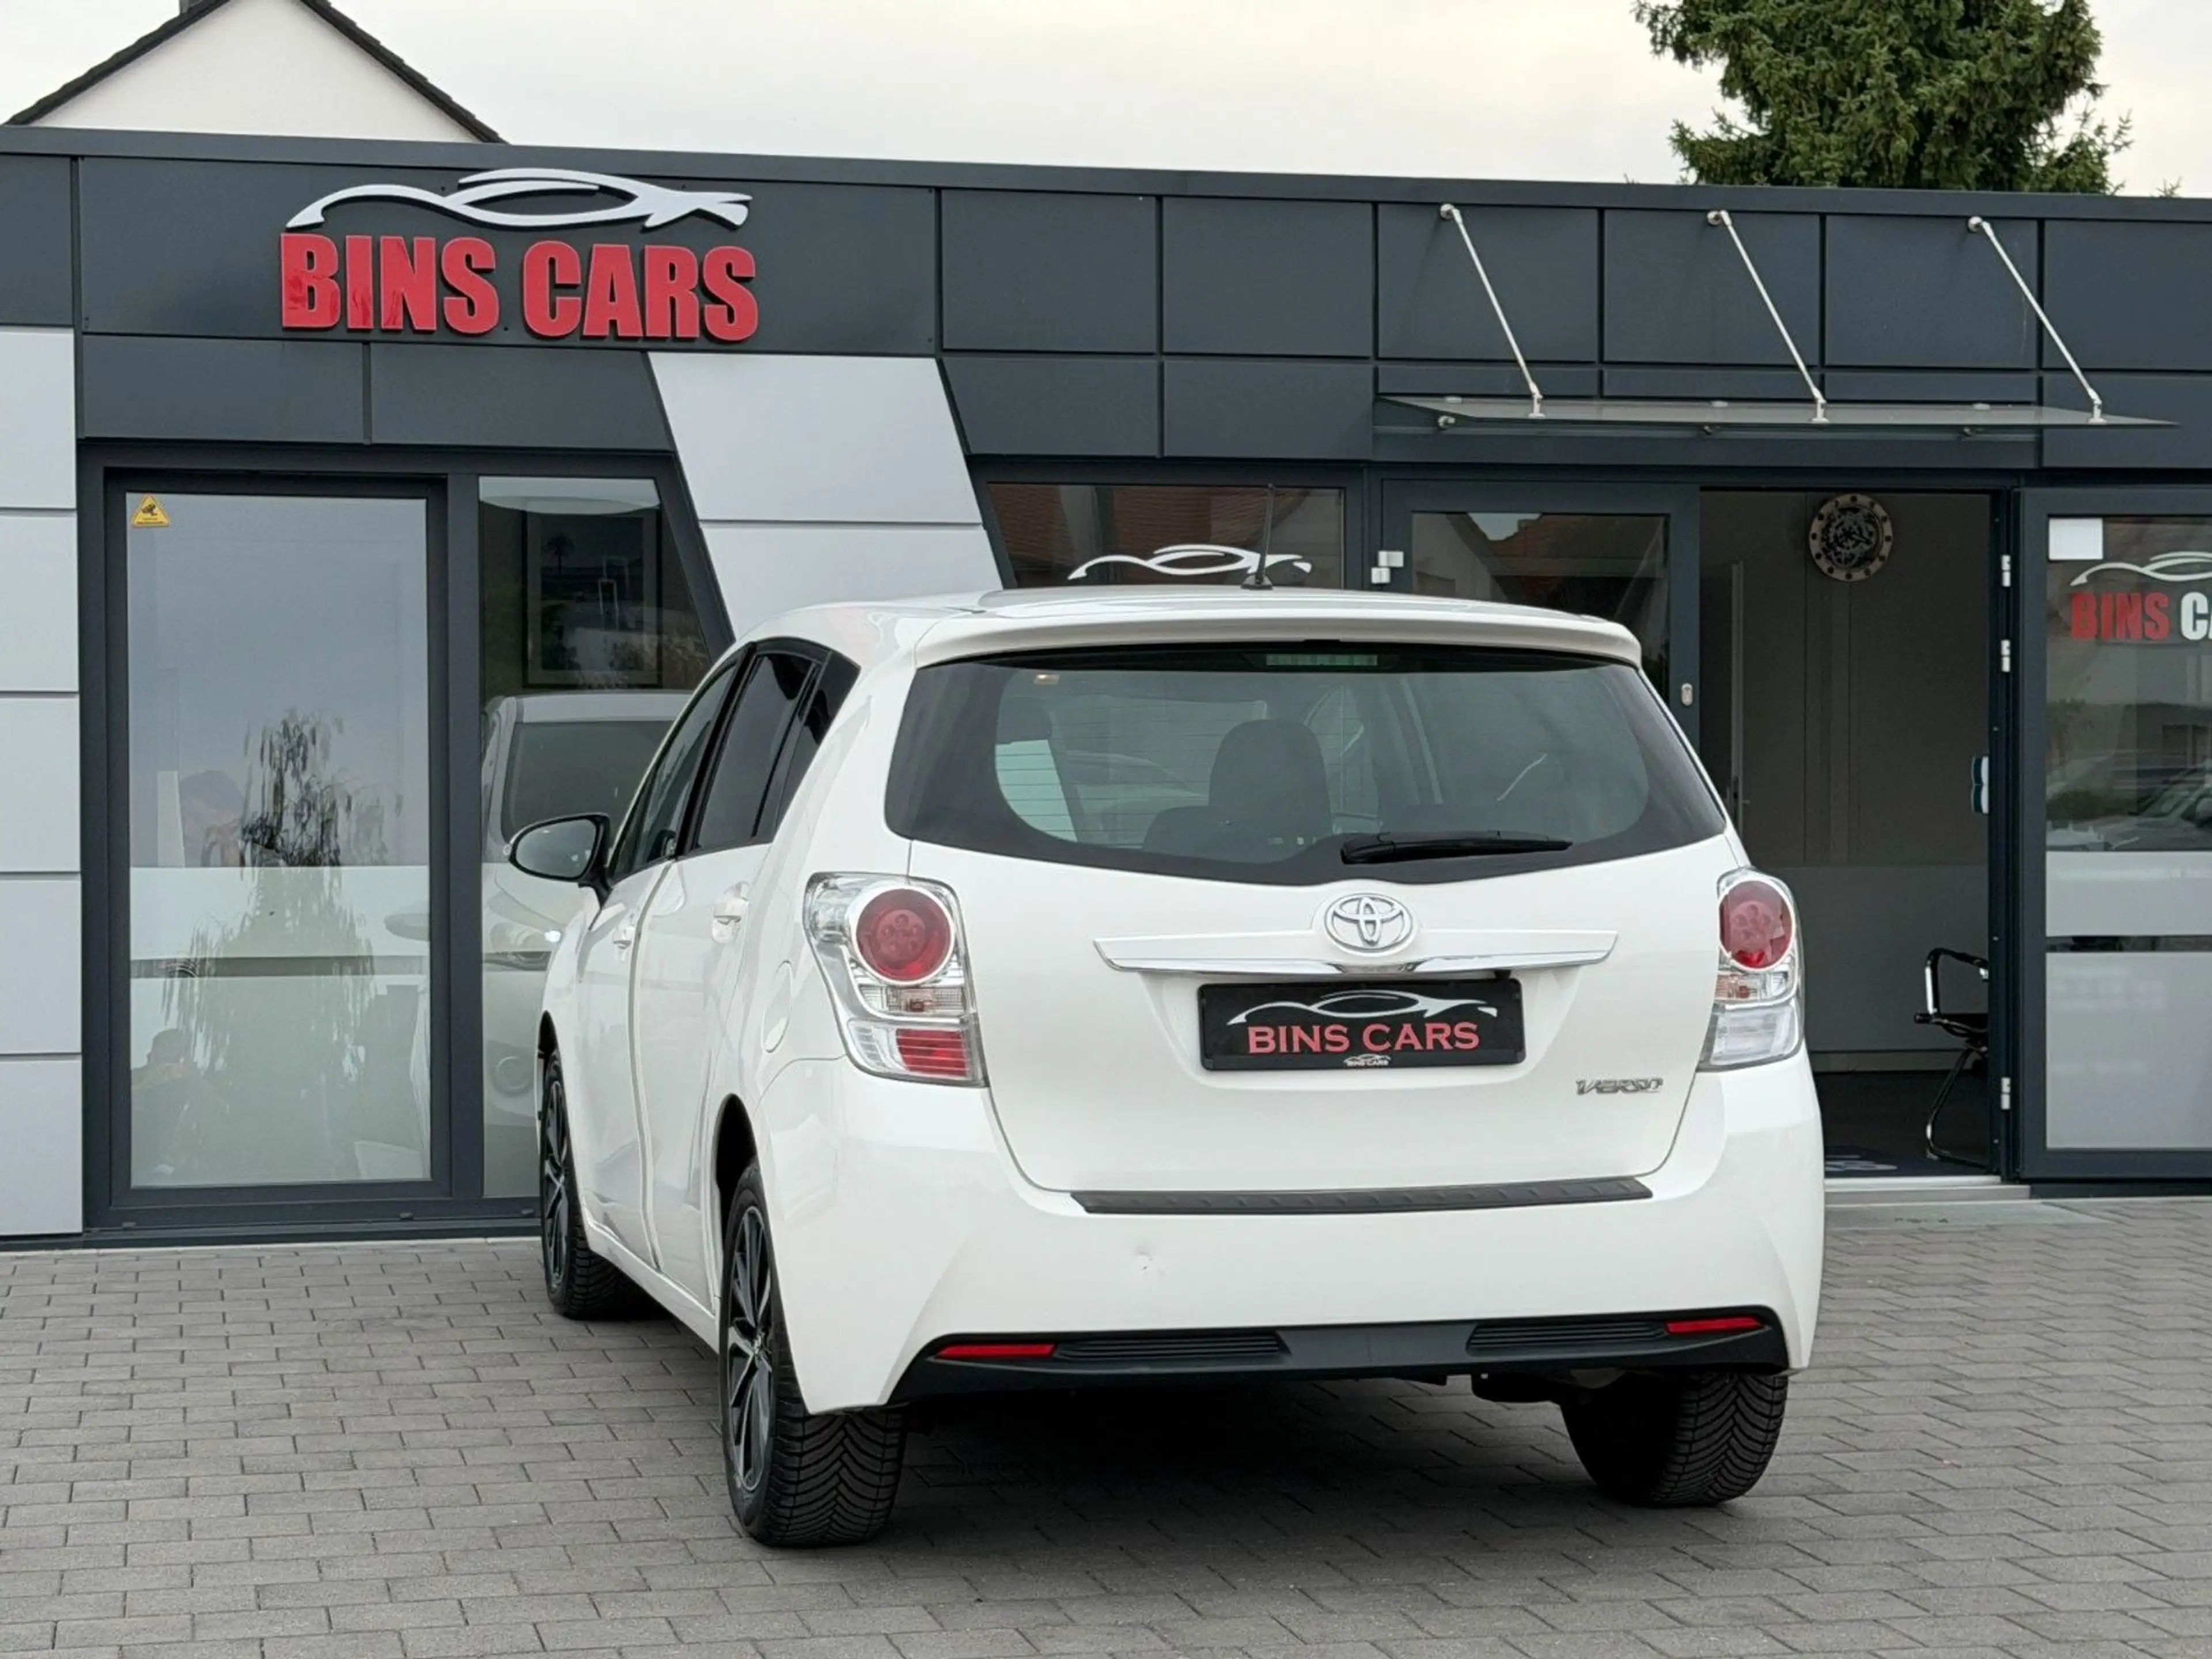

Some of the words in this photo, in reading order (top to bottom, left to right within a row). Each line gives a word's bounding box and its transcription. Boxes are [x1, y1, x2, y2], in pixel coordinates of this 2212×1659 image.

[281, 233, 499, 335] BINS
[522, 240, 759, 342] CARS
[2070, 591, 2170, 641] BINS
[2181, 592, 2212, 640] C
[1247, 1024, 1350, 1054] BINS
[1362, 1021, 1480, 1052] CARS
